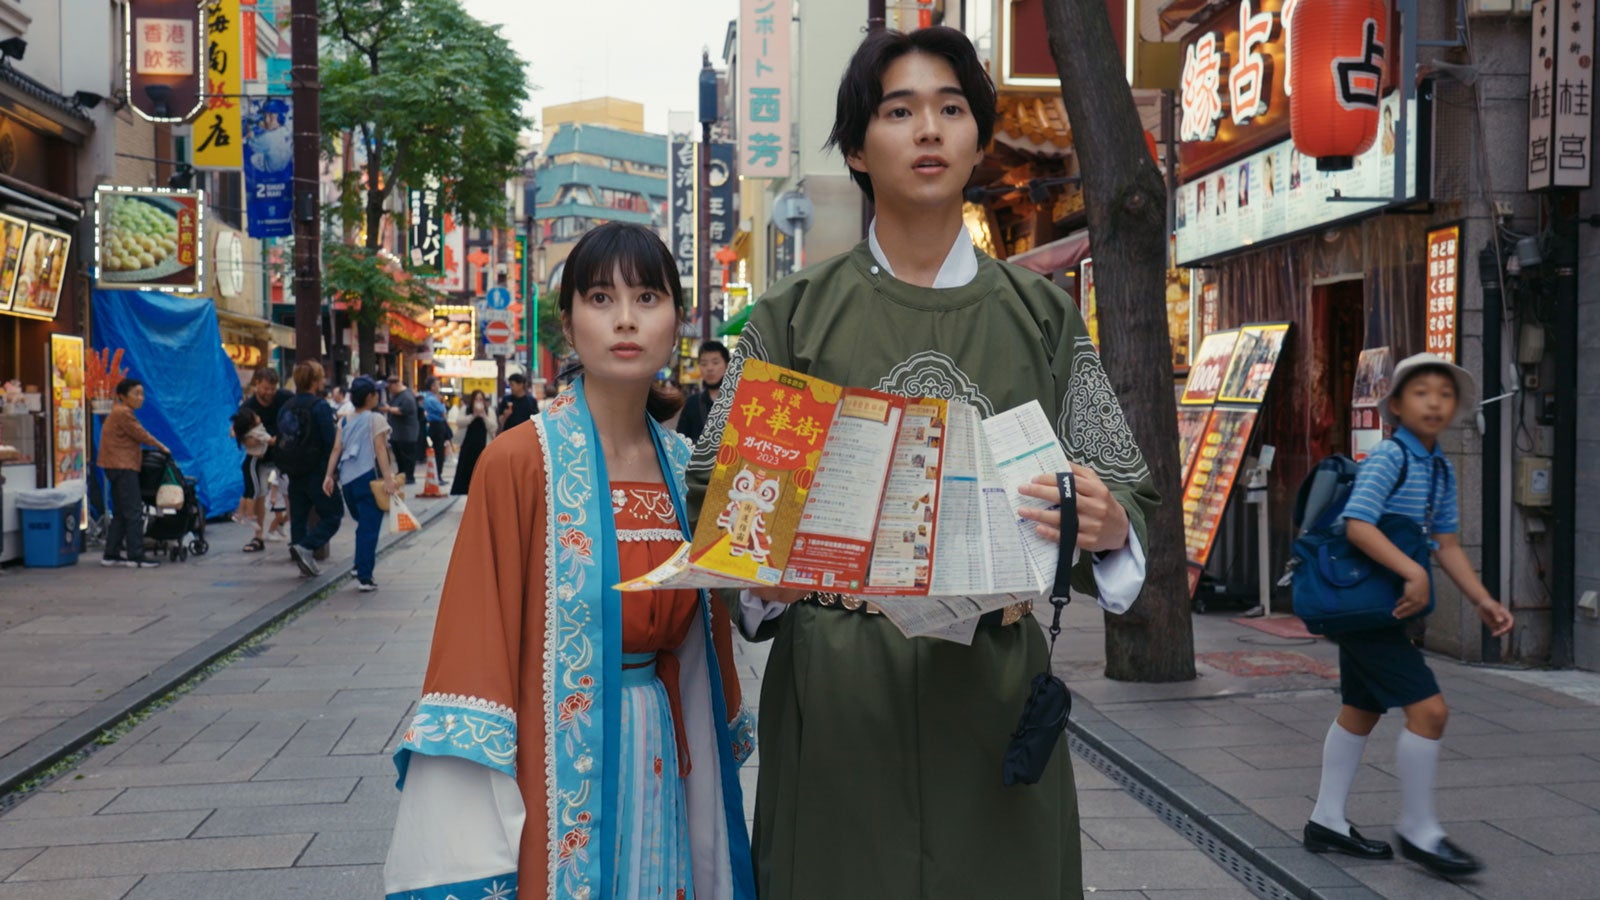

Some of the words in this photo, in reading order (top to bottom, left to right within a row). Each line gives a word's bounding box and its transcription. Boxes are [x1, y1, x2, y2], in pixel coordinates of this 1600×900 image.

[144, 23, 186, 44] 香港
[144, 49, 186, 68] 飲茶
[1331, 18, 1384, 109] 占
[1180, 0, 1297, 142] 縁占
[256, 183, 266, 198] 2
[740, 397, 824, 446] 中華街
[743, 436, 801, 461] ガイドマップ
[756, 452, 780, 466] 2023
